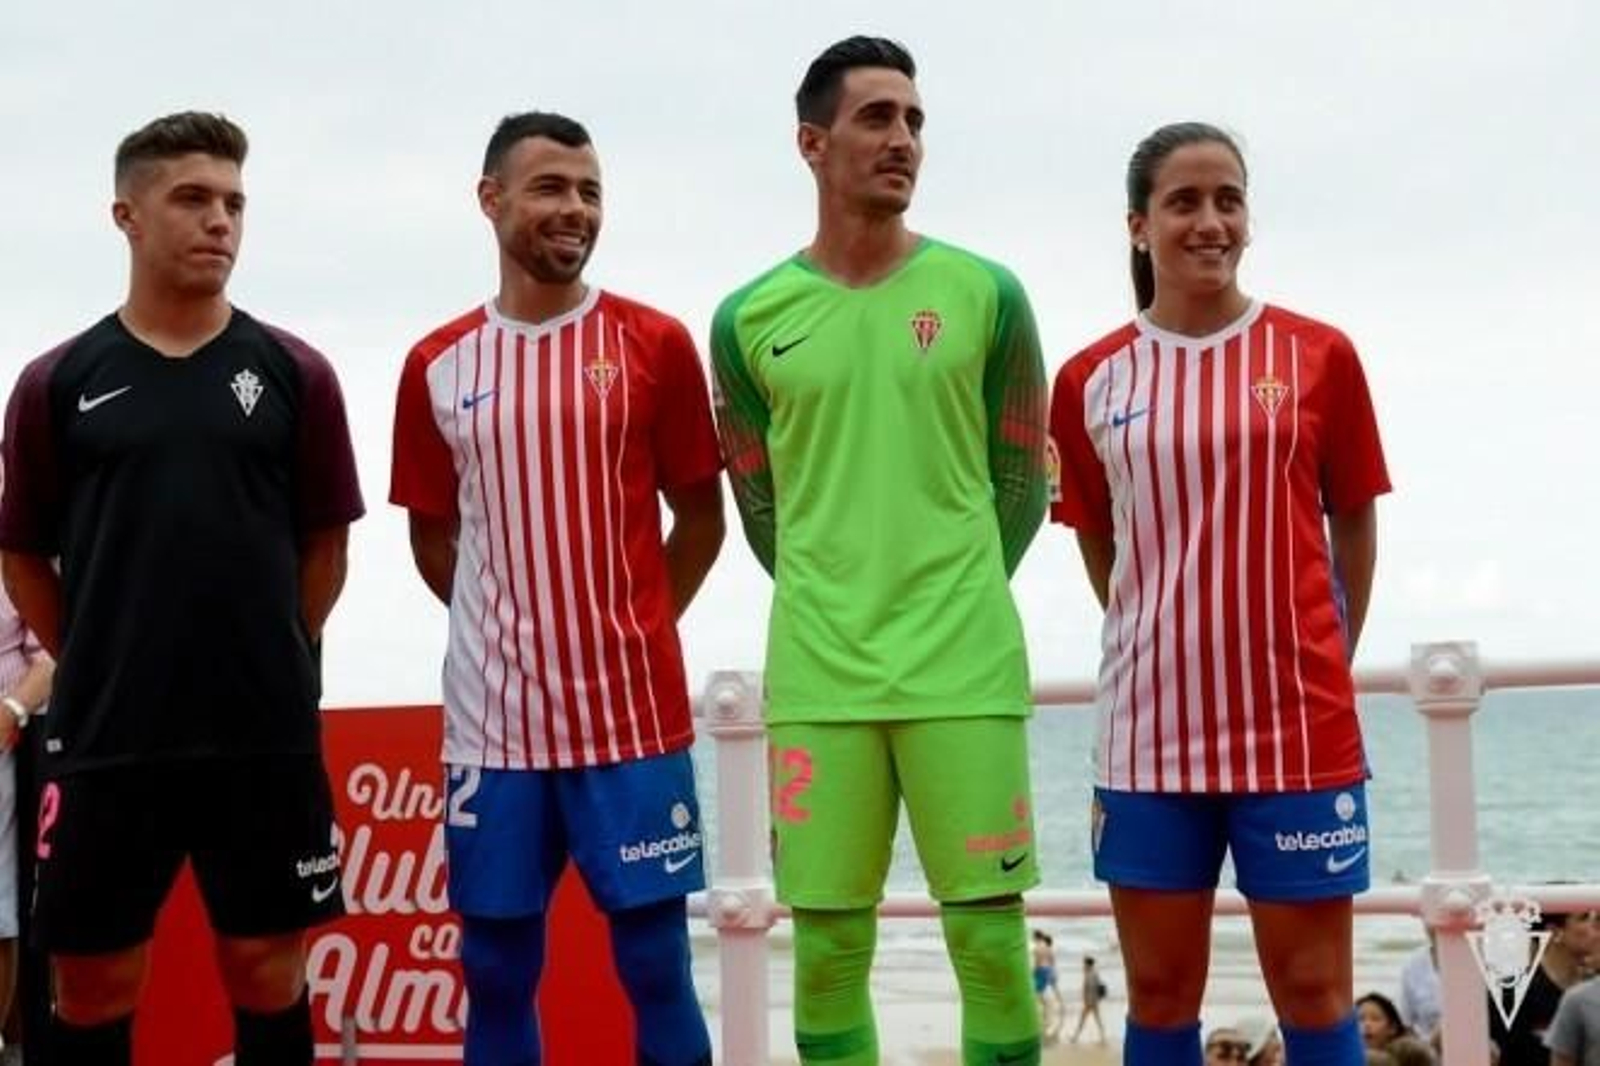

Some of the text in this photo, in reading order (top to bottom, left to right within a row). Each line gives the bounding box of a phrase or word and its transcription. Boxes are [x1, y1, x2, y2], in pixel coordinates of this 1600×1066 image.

[347, 763, 443, 820] Un
[334, 824, 449, 914] lub
[306, 932, 469, 1033] Alm
